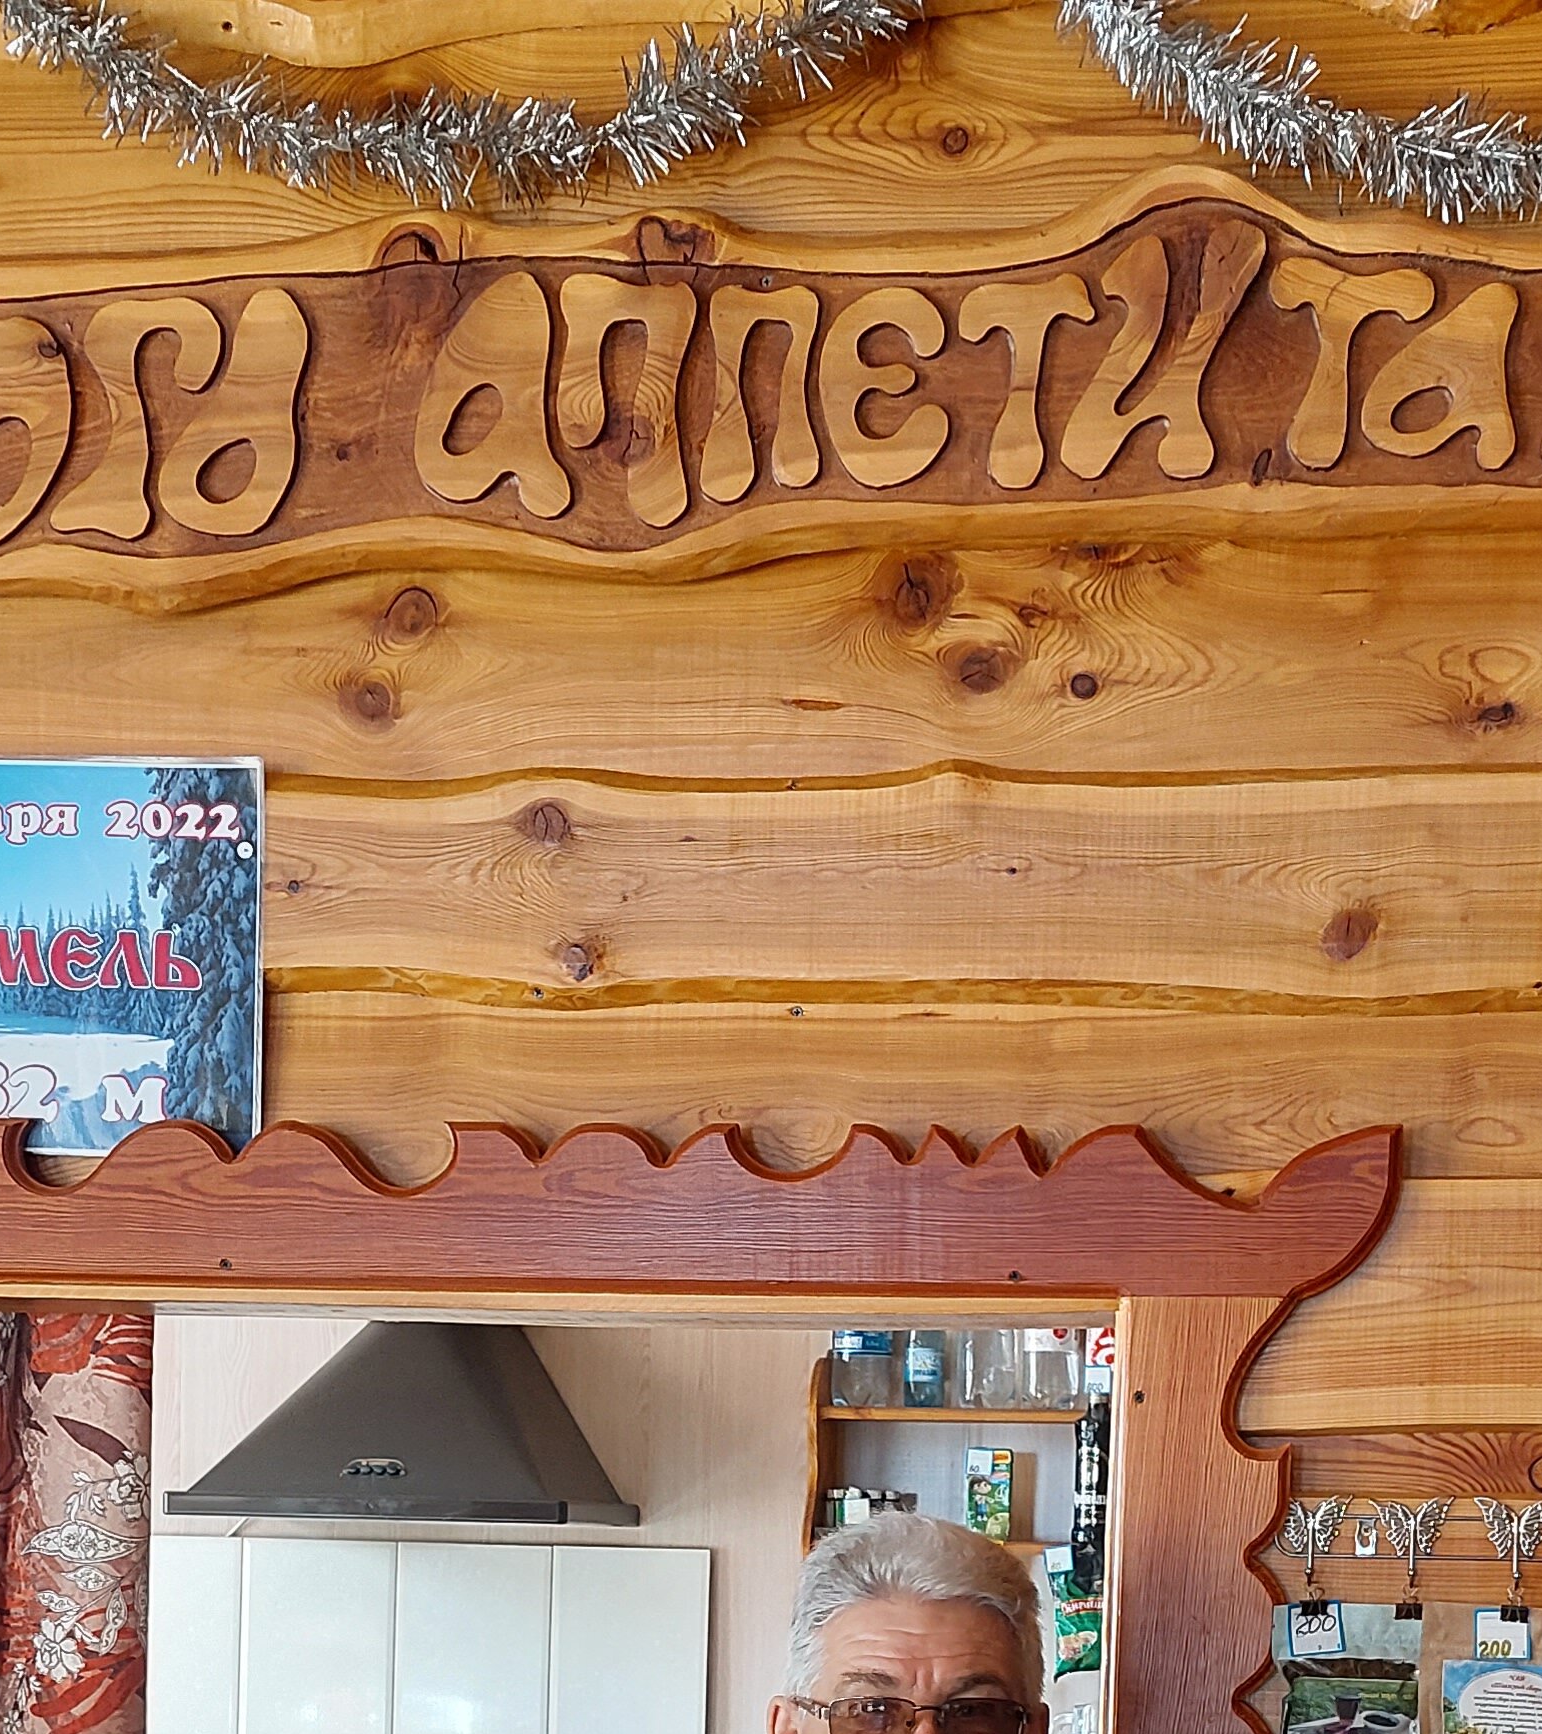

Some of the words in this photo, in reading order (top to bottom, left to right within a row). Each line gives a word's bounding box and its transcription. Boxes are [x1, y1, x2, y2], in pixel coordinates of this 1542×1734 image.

[104, 800, 241, 840] 2022
[1295, 1613, 1337, 1637] 200
[1478, 1639, 1512, 1658] 200
